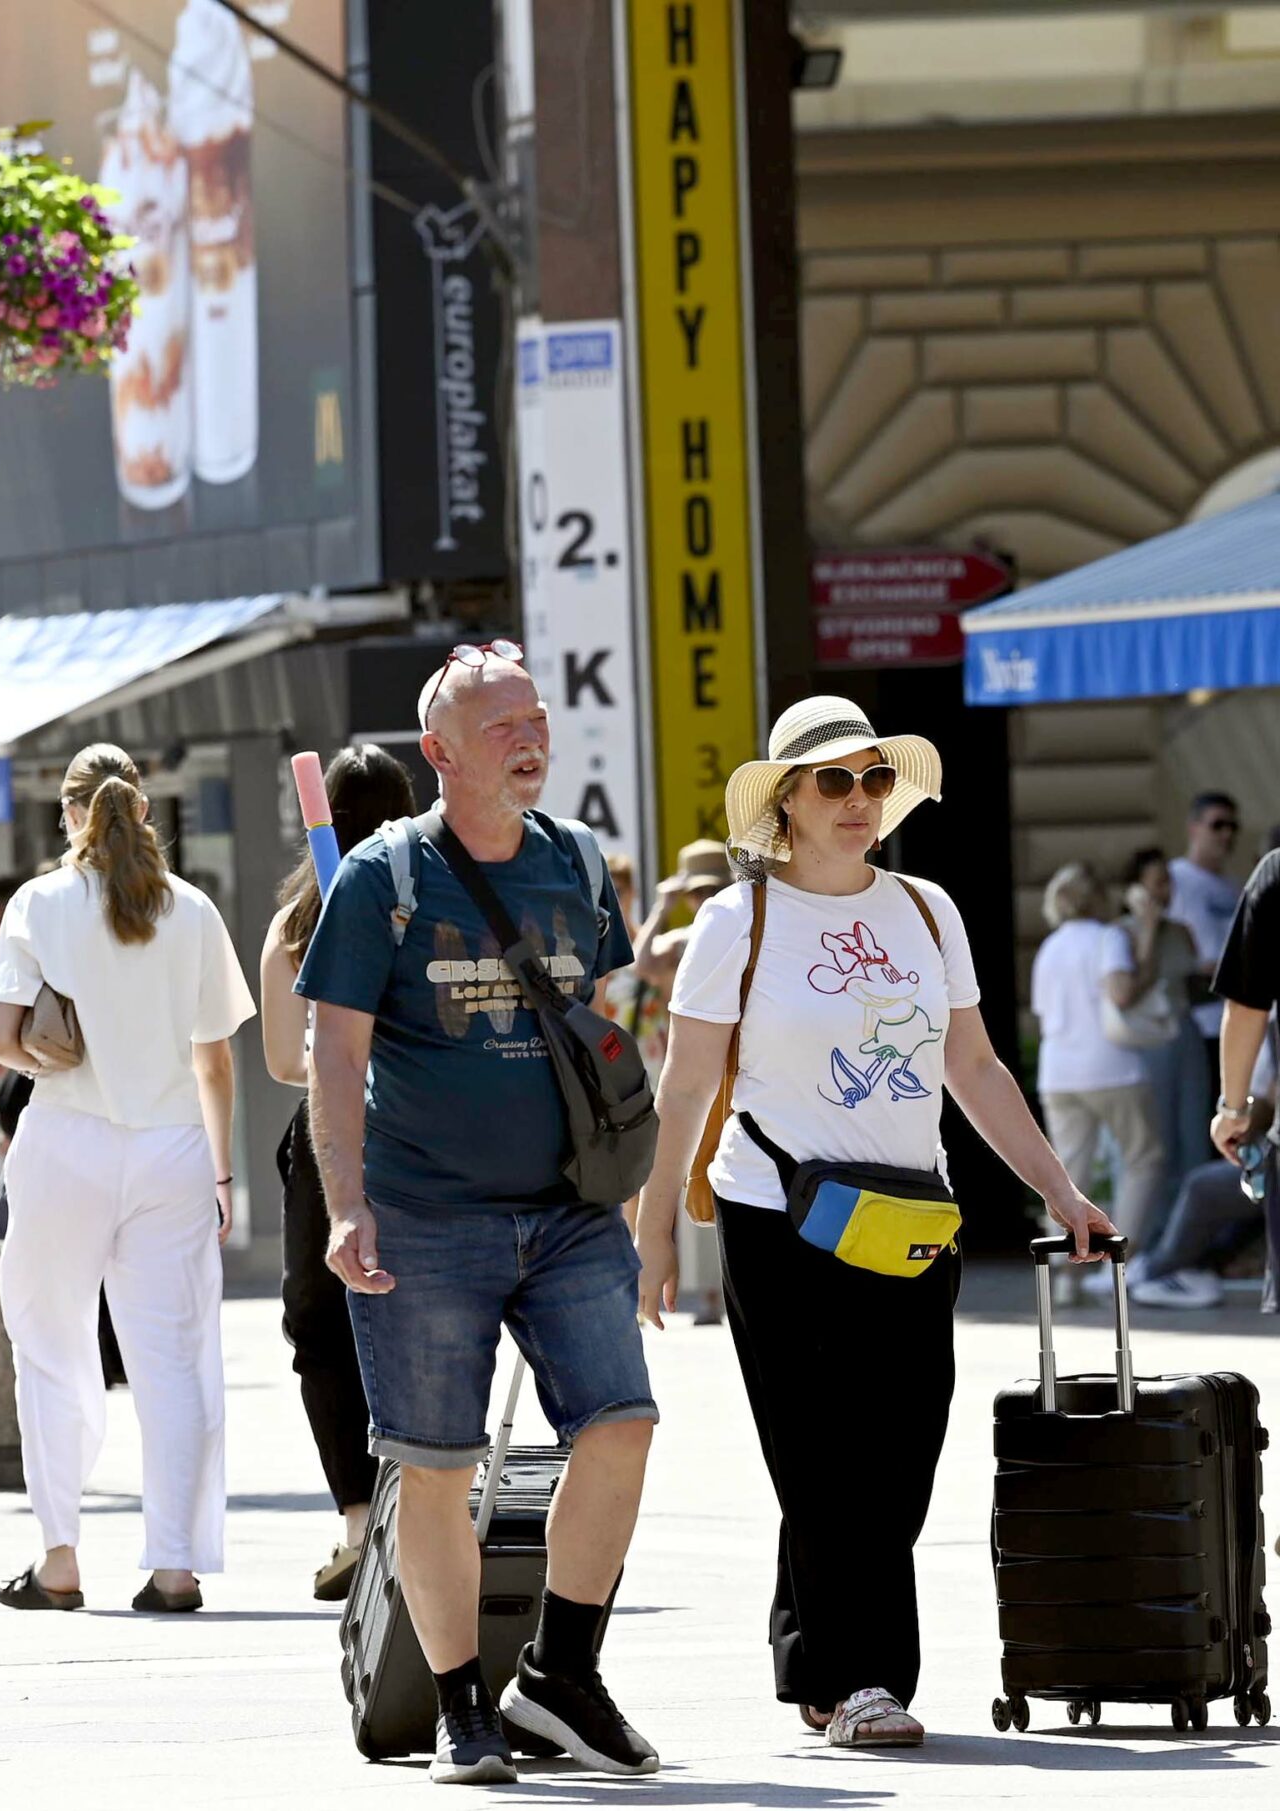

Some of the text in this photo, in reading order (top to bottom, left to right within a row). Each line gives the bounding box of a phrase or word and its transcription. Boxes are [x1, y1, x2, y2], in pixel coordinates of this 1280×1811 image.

[437, 273, 487, 522] europlakat
[665, 2, 723, 711] HAPPY HOME
[556, 508, 620, 571] 2.
